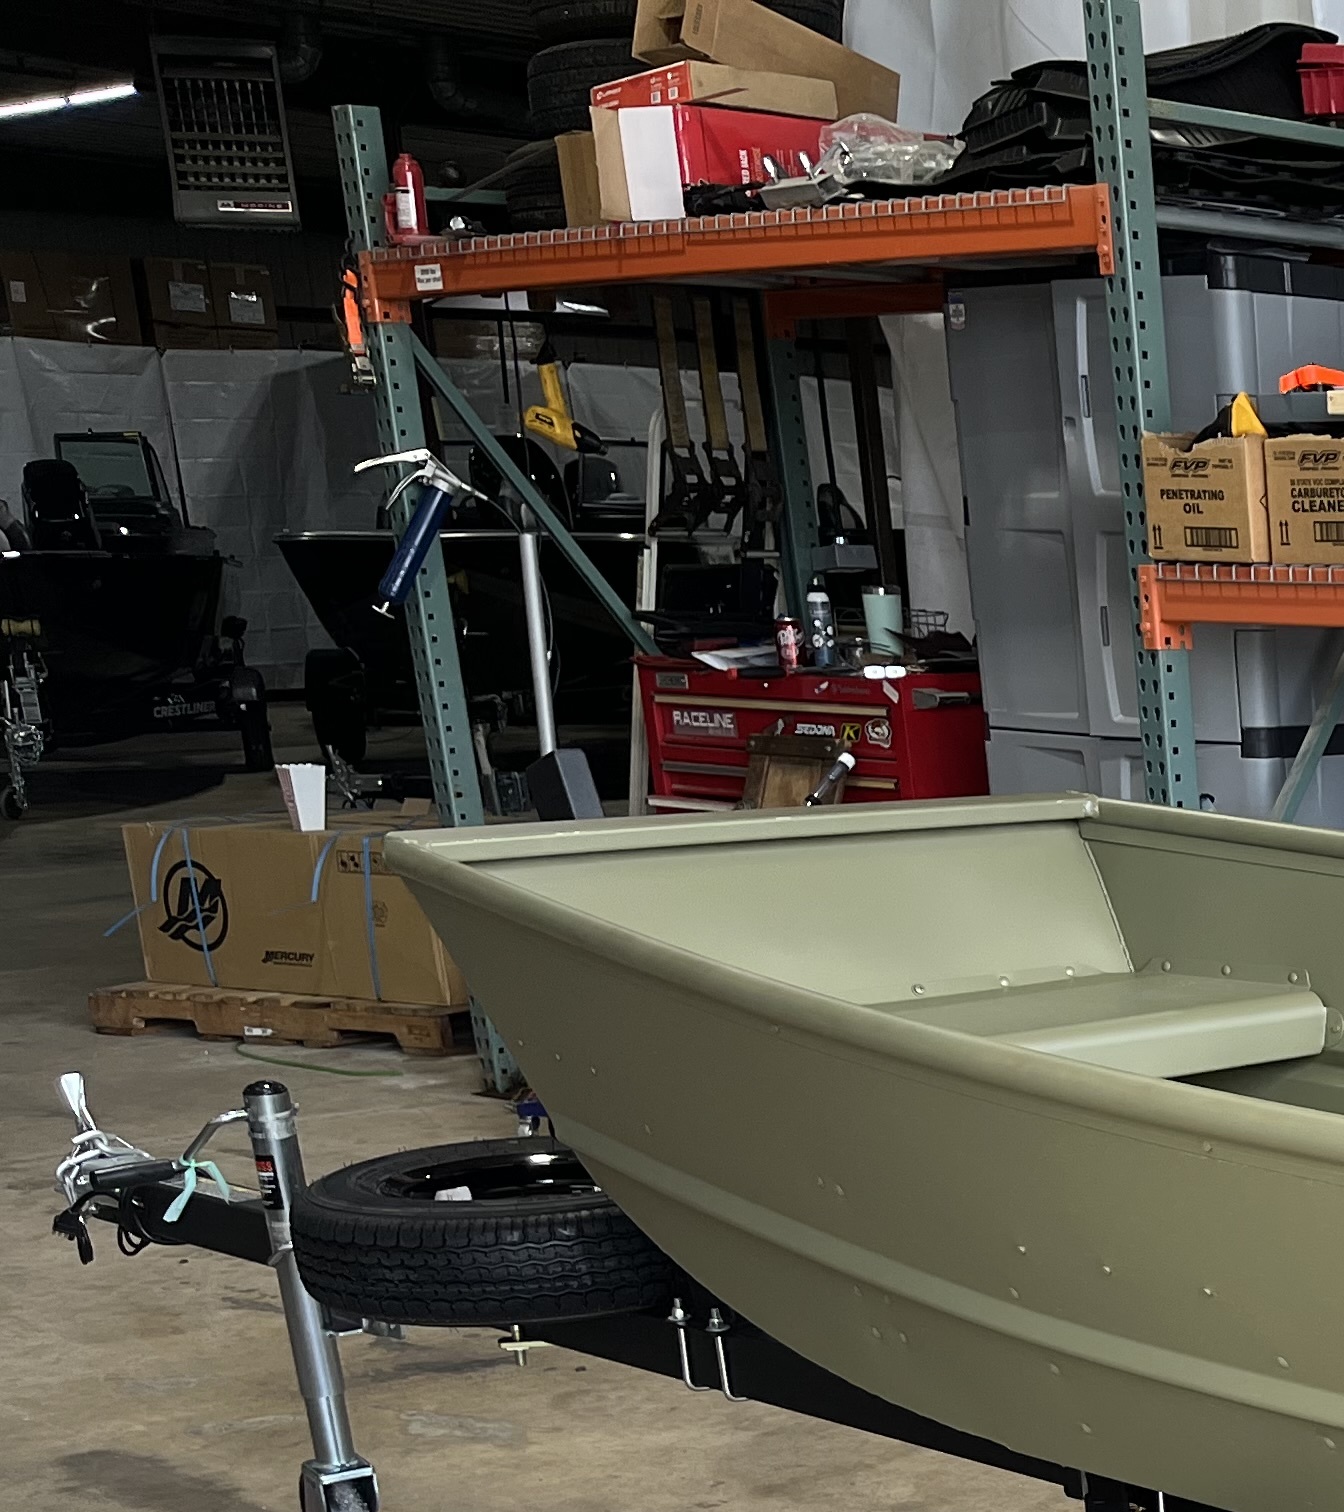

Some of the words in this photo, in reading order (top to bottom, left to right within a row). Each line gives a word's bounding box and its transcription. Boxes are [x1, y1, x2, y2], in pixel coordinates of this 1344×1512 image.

[1299, 451, 1339, 465] FVP
[1170, 459, 1209, 472] FVP
[1160, 488, 1225, 501] PENETRATING
[1183, 502, 1204, 515] OIL
[153, 700, 217, 719] CRESTLINER
[672, 710, 734, 729] RACELINE
[262, 950, 315, 964] MERCURY
